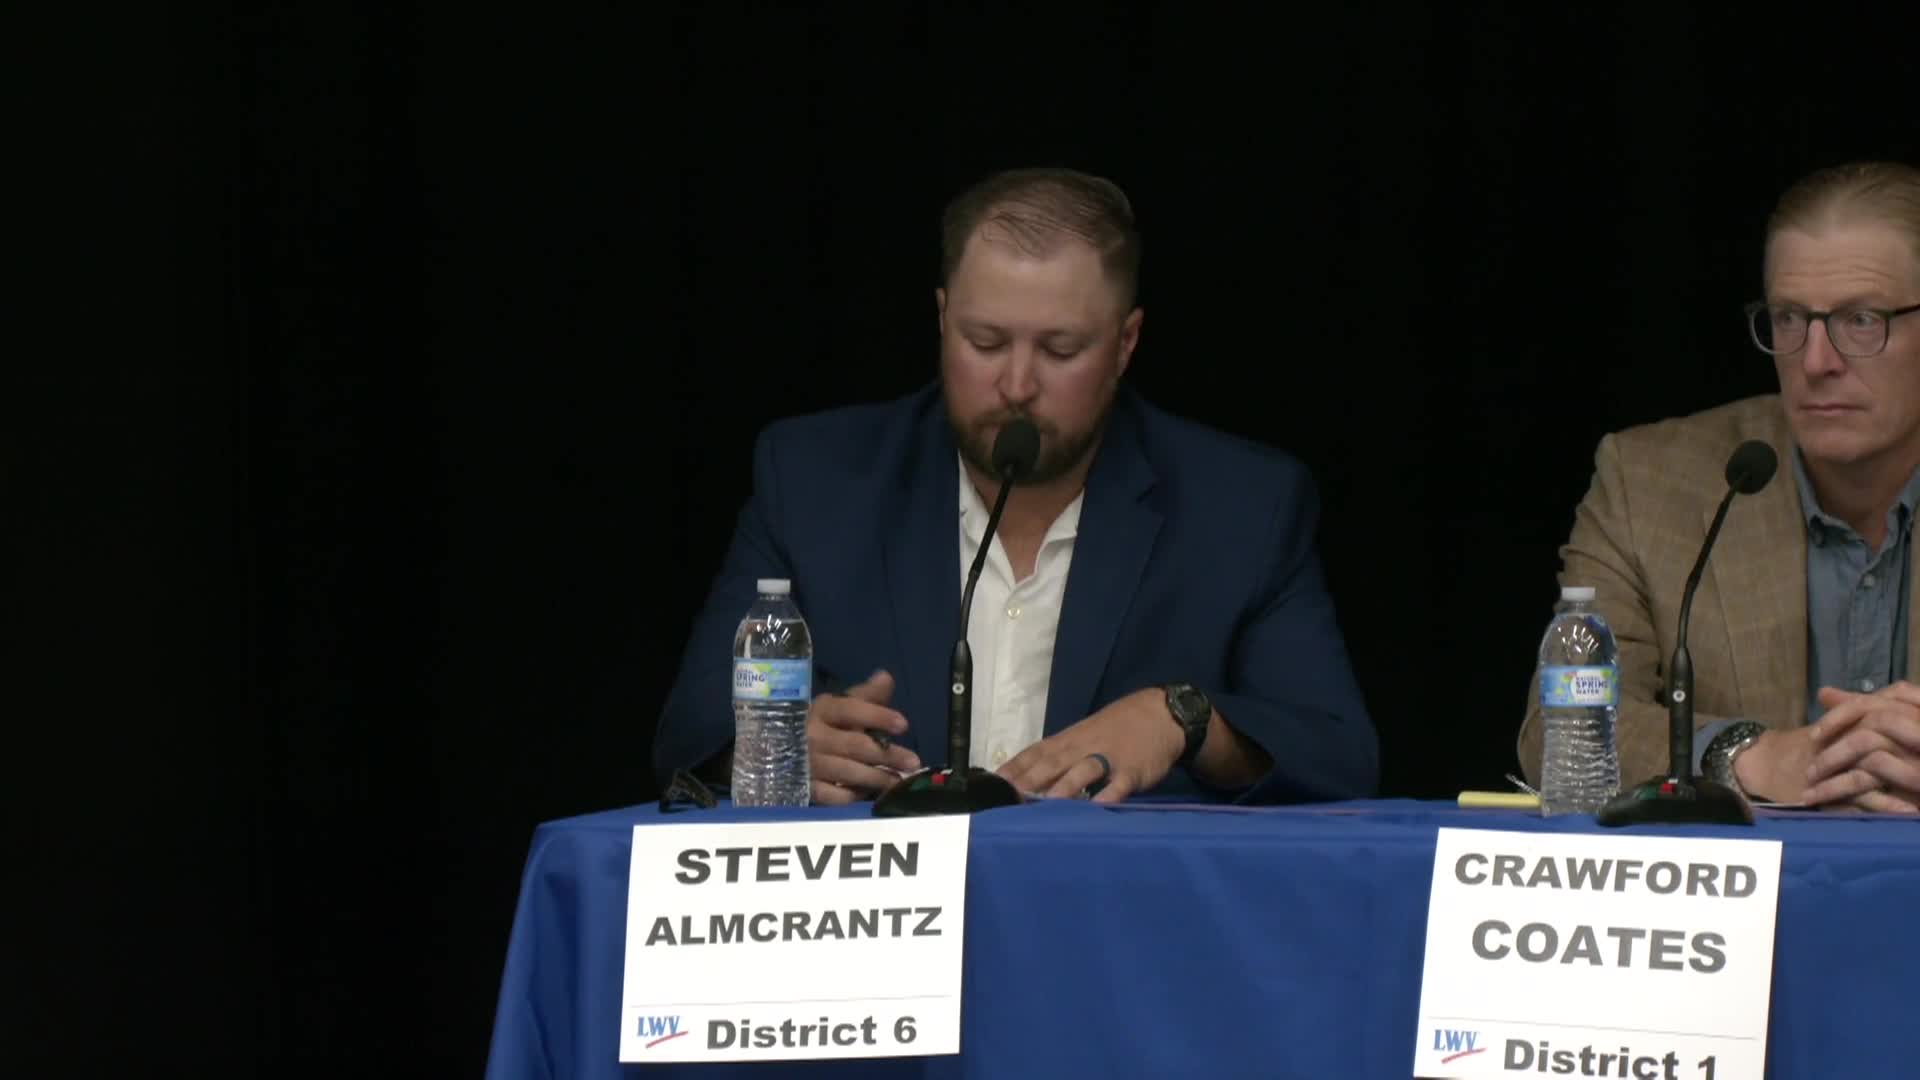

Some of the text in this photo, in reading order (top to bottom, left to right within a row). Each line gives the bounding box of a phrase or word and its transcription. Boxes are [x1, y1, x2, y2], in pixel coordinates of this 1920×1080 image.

[674, 841, 920, 885] STEVEN
[1454, 852, 1758, 898] CRAWFORD
[644, 906, 943, 947] ALMCRANTZ
[1471, 919, 1727, 974] COATES
[636, 1015, 681, 1038] LWV
[706, 1015, 917, 1050] District 6
[1433, 1029, 1480, 1053] LWV
[1503, 1038, 1717, 1080] District 1
